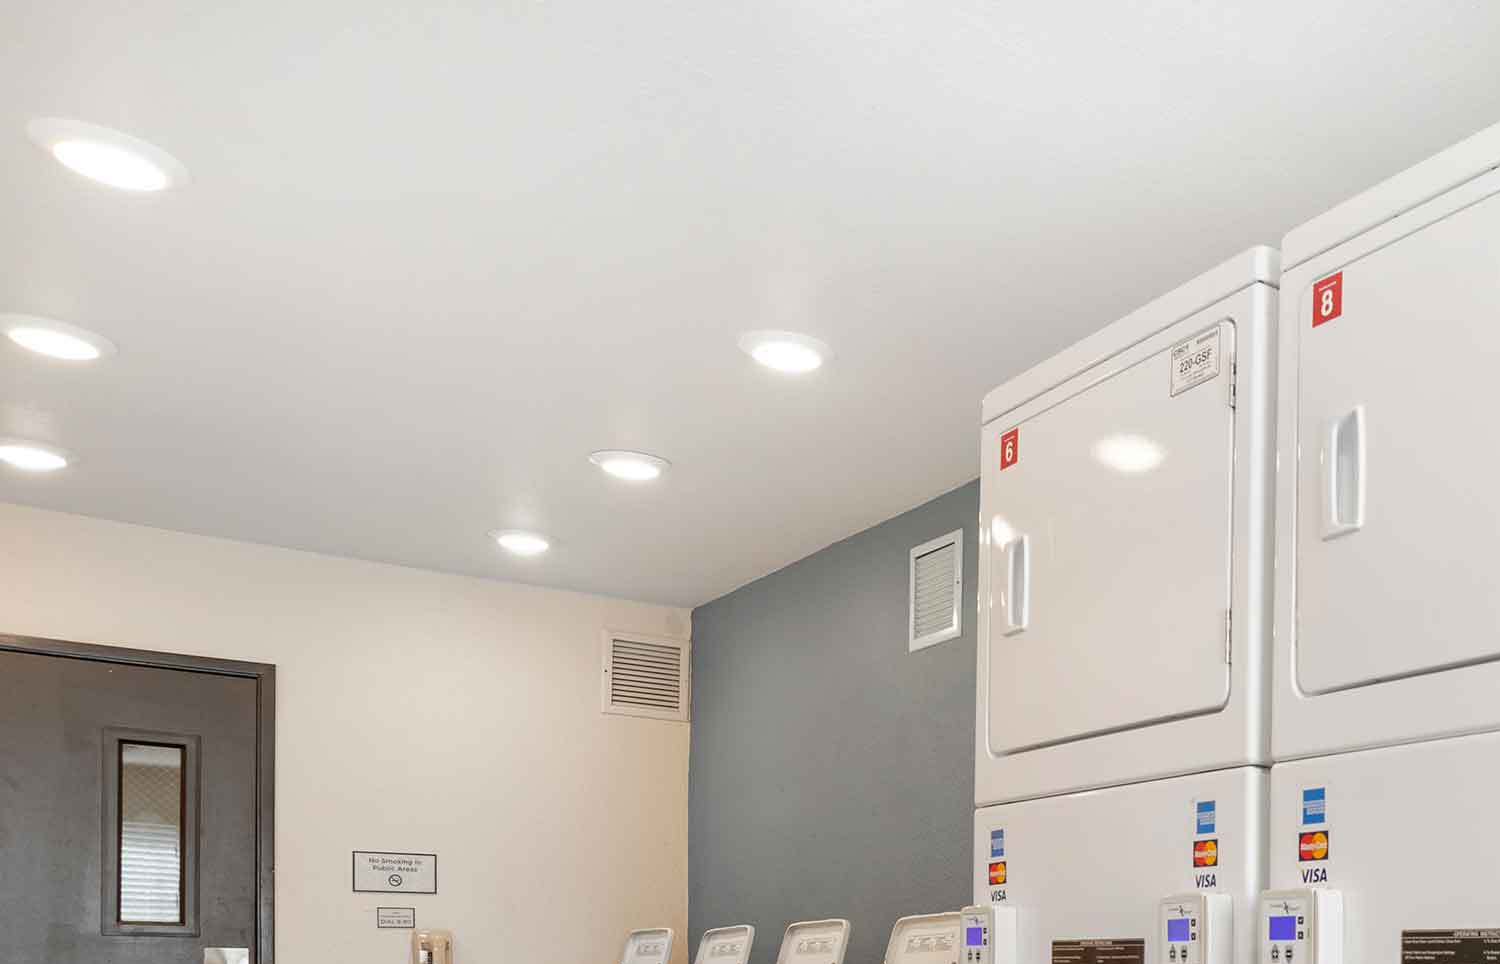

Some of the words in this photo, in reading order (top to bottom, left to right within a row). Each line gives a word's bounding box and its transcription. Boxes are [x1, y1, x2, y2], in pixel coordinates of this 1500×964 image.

[1321, 289, 1333, 317] 8
[1180, 348, 1212, 373] 220-GSF
[1005, 441, 1013, 462] 6
[1195, 873, 1216, 888] VISA
[1302, 868, 1328, 884] VISA
[991, 889, 1007, 902] VISA
